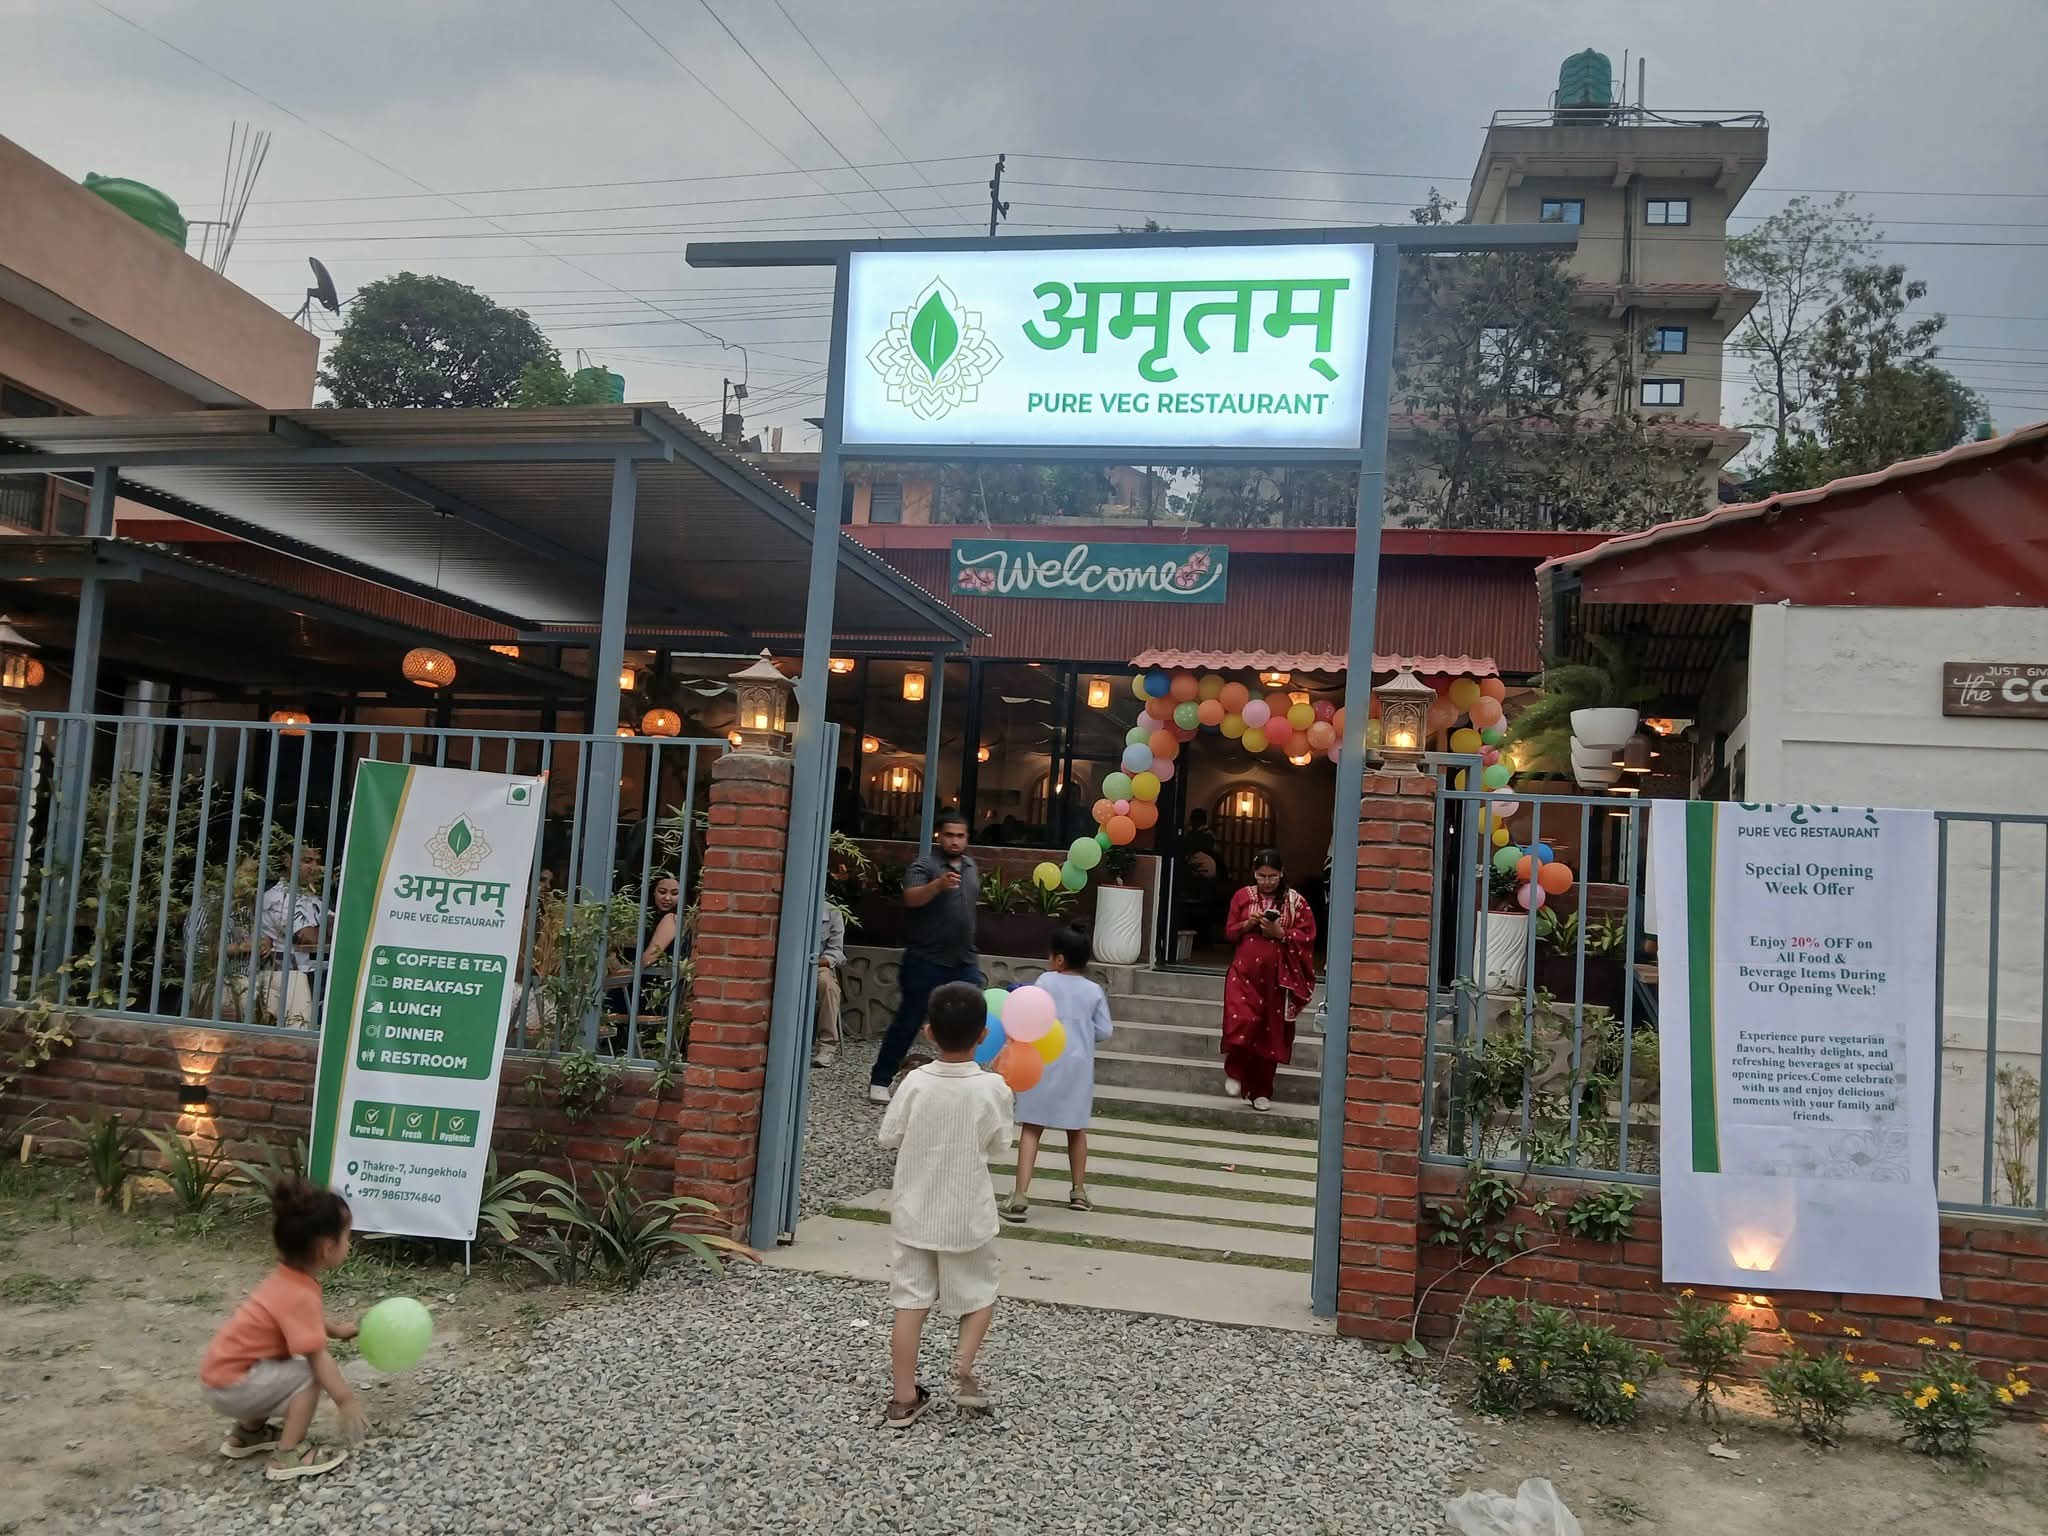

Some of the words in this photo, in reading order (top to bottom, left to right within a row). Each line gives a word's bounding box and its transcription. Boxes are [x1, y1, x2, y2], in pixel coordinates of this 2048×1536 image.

[1022, 279, 1350, 382] अमृतम्
[1028, 393, 1092, 413] PURE
[1098, 393, 1149, 413] VEG
[1158, 393, 1329, 415] RESTAURANT
[957, 544, 1222, 594] Welcome
[1986, 667, 2020, 676] JUST
[1953, 674, 1995, 706] the
[1739, 827, 1769, 837] PURE
[1773, 828, 1797, 837] VEG
[1801, 828, 1880, 838] RESTAURANT
[1745, 862, 1800, 878] Special
[1806, 863, 1873, 880] Opening
[394, 874, 510, 917] अमृतम्
[1766, 882, 1808, 895] Week
[1813, 883, 1854, 895] Offer
[390, 911, 416, 921] PURE
[420, 914, 438, 923] VEG
[442, 916, 505, 928] RESTAURANT
[1750, 936, 1787, 949] Enjoy
[1791, 937, 1819, 948] 20%
[1824, 938, 1853, 948] OFF
[1858, 941, 1872, 949] on
[396, 953, 456, 970] COFFEE
[459, 959, 469, 970] &
[473, 960, 502, 972] TEA
[1776, 952, 1795, 962] All
[1800, 953, 1830, 963] Food
[1835, 953, 1846, 963] &
[1739, 966, 1796, 980] Beverage
[1801, 968, 1836, 979] Items
[1840, 968, 1886, 982] During
[392, 977, 483, 995] BREAKFAST
[1749, 982, 1774, 992] Our
[1778, 983, 1832, 996] Opening
[1836, 984, 1876, 995] Week!
[389, 1001, 442, 1017] LUNCH
[385, 1026, 444, 1042] DINNER
[1740, 1031, 1797, 1042] Experience
[1801, 1035, 1825, 1043] pure
[1829, 1035, 1884, 1045] vegetarian
[1736, 1044, 1775, 1054] flavors,
[1778, 1045, 1816, 1057] healthy
[1820, 1047, 1864, 1058] delights,
[1868, 1049, 1888, 1057] and
[380, 1050, 468, 1069] RESTROOM
[1732, 1057, 1785, 1069] refreshing
[1788, 1060, 1840, 1070] beverages
[1857, 1062, 1893, 1072] special
[1732, 1071, 1773, 1081] opening
[1845, 1075, 1894, 1084] celebrate
[1742, 1083, 1764, 1092] with
[1783, 1086, 1802, 1094] and
[1806, 1087, 1834, 1096] enjoy
[1838, 1088, 1884, 1097] delicious
[1732, 1098, 1780, 1106] moments
[1783, 1098, 1806, 1107] with
[1809, 1101, 1834, 1110] your
[1838, 1100, 1871, 1112] family
[1875, 1102, 1895, 1111] and
[1793, 1111, 1834, 1122] friends.
[356, 1125, 370, 1134] Pure
[402, 1130, 422, 1139] Fresh
[440, 1133, 470, 1142] Hygienic
[363, 1161, 407, 1174] Thakre-7,
[409, 1165, 467, 1178] Jungekhola
[361, 1173, 401, 1186] Dhading
[358, 1188, 379, 1198] +977
[382, 1190, 441, 1203] 9861374840
